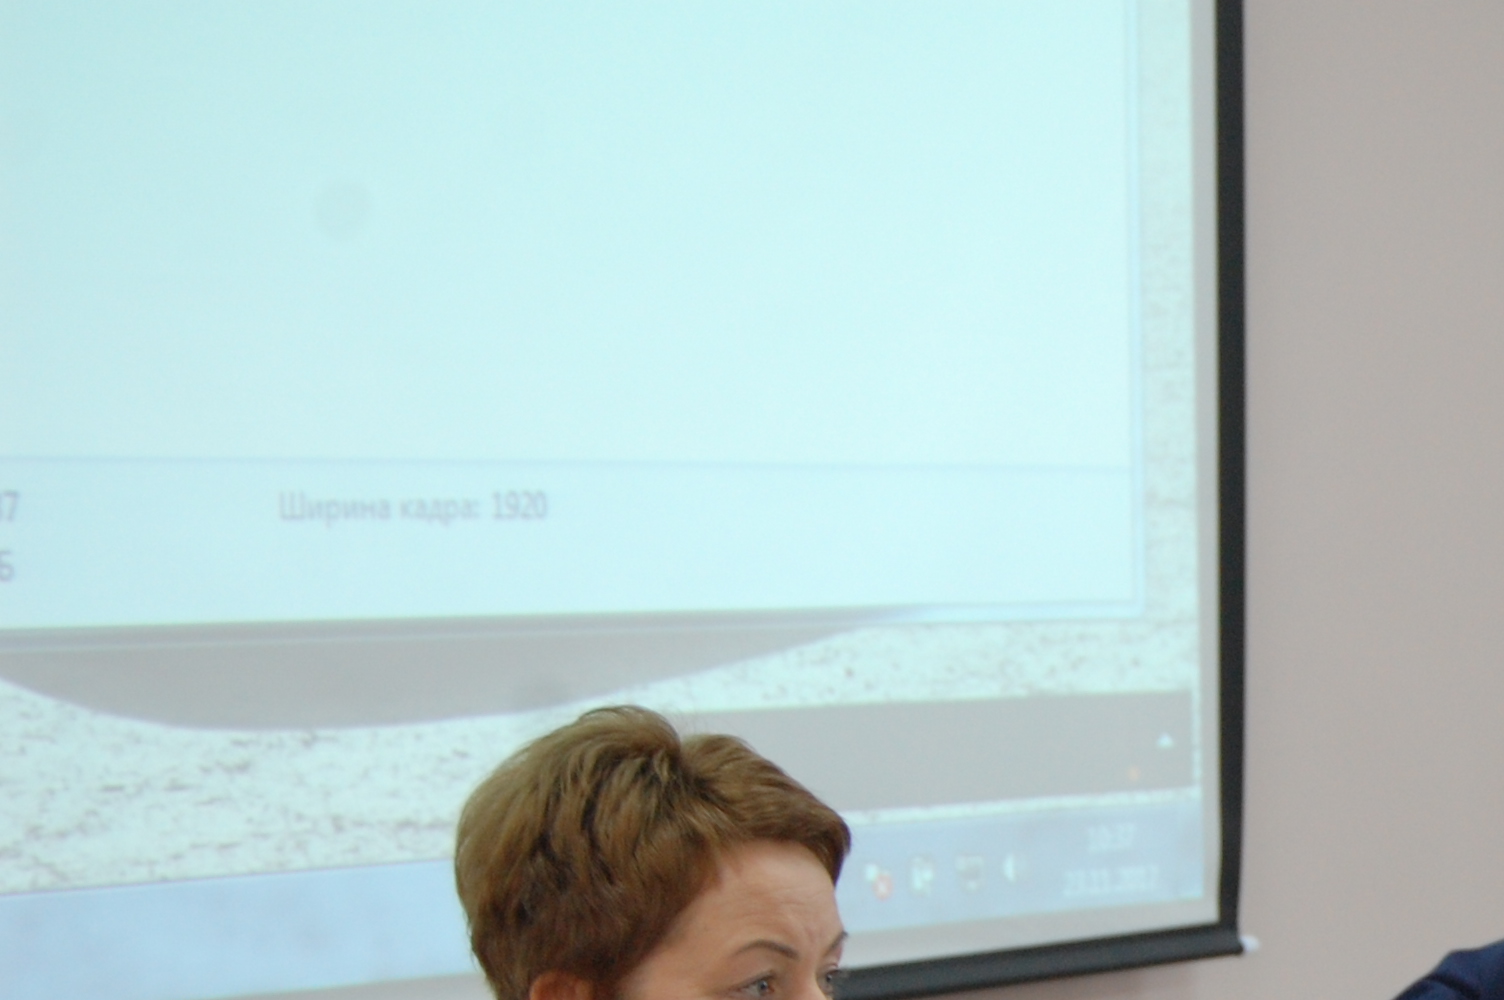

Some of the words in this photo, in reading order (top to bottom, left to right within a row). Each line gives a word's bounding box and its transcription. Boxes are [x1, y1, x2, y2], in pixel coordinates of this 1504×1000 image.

[279, 491, 391, 528] Ширина
[399, 499, 480, 528] кадра:
[490, 489, 548, 521] 1920
